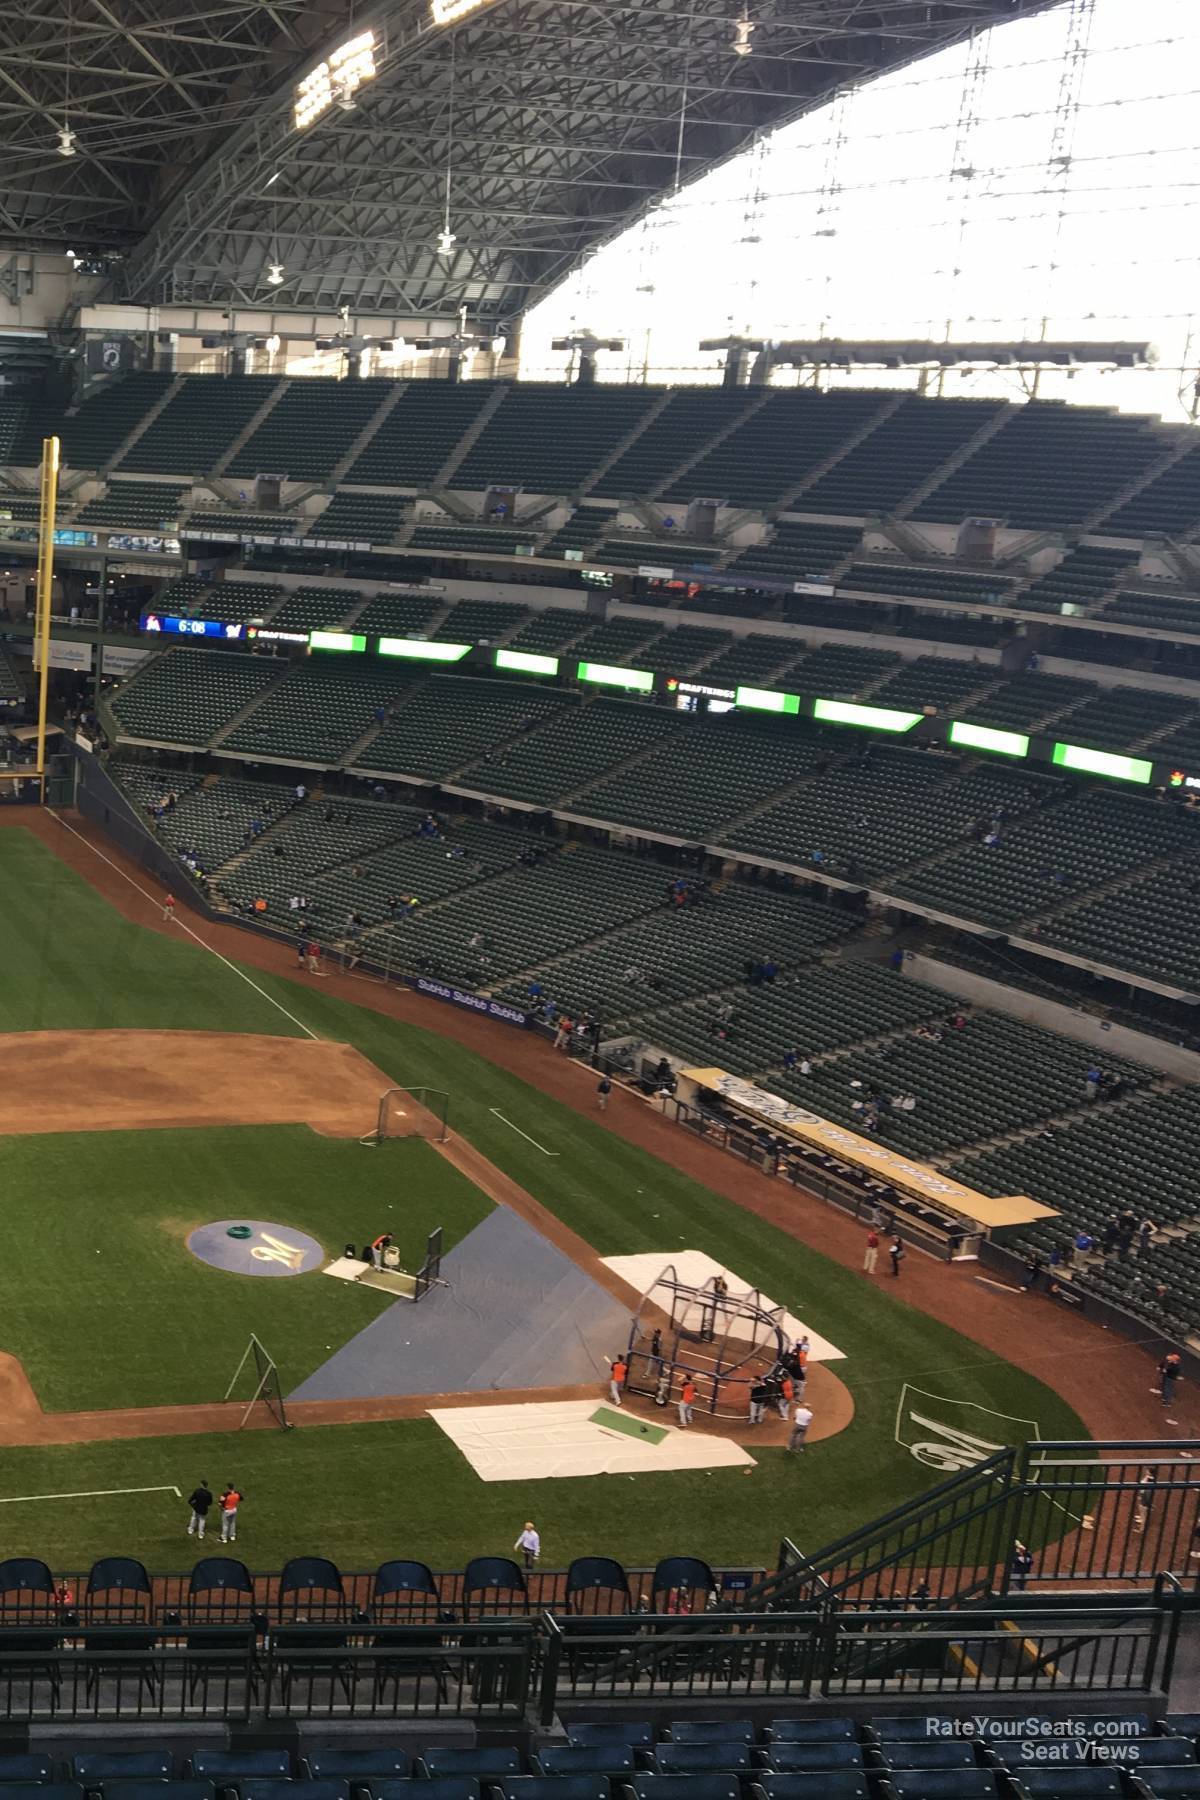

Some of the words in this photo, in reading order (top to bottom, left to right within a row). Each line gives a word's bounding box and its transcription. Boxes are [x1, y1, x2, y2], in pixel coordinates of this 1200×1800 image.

[678, 682, 736, 699] DRAFTKINGS
[417, 978, 451, 998] StubHub
[452, 990, 488, 1010] StubHub
[489, 1003, 526, 1024] StubHub
[888, 1160, 968, 1199] Home
